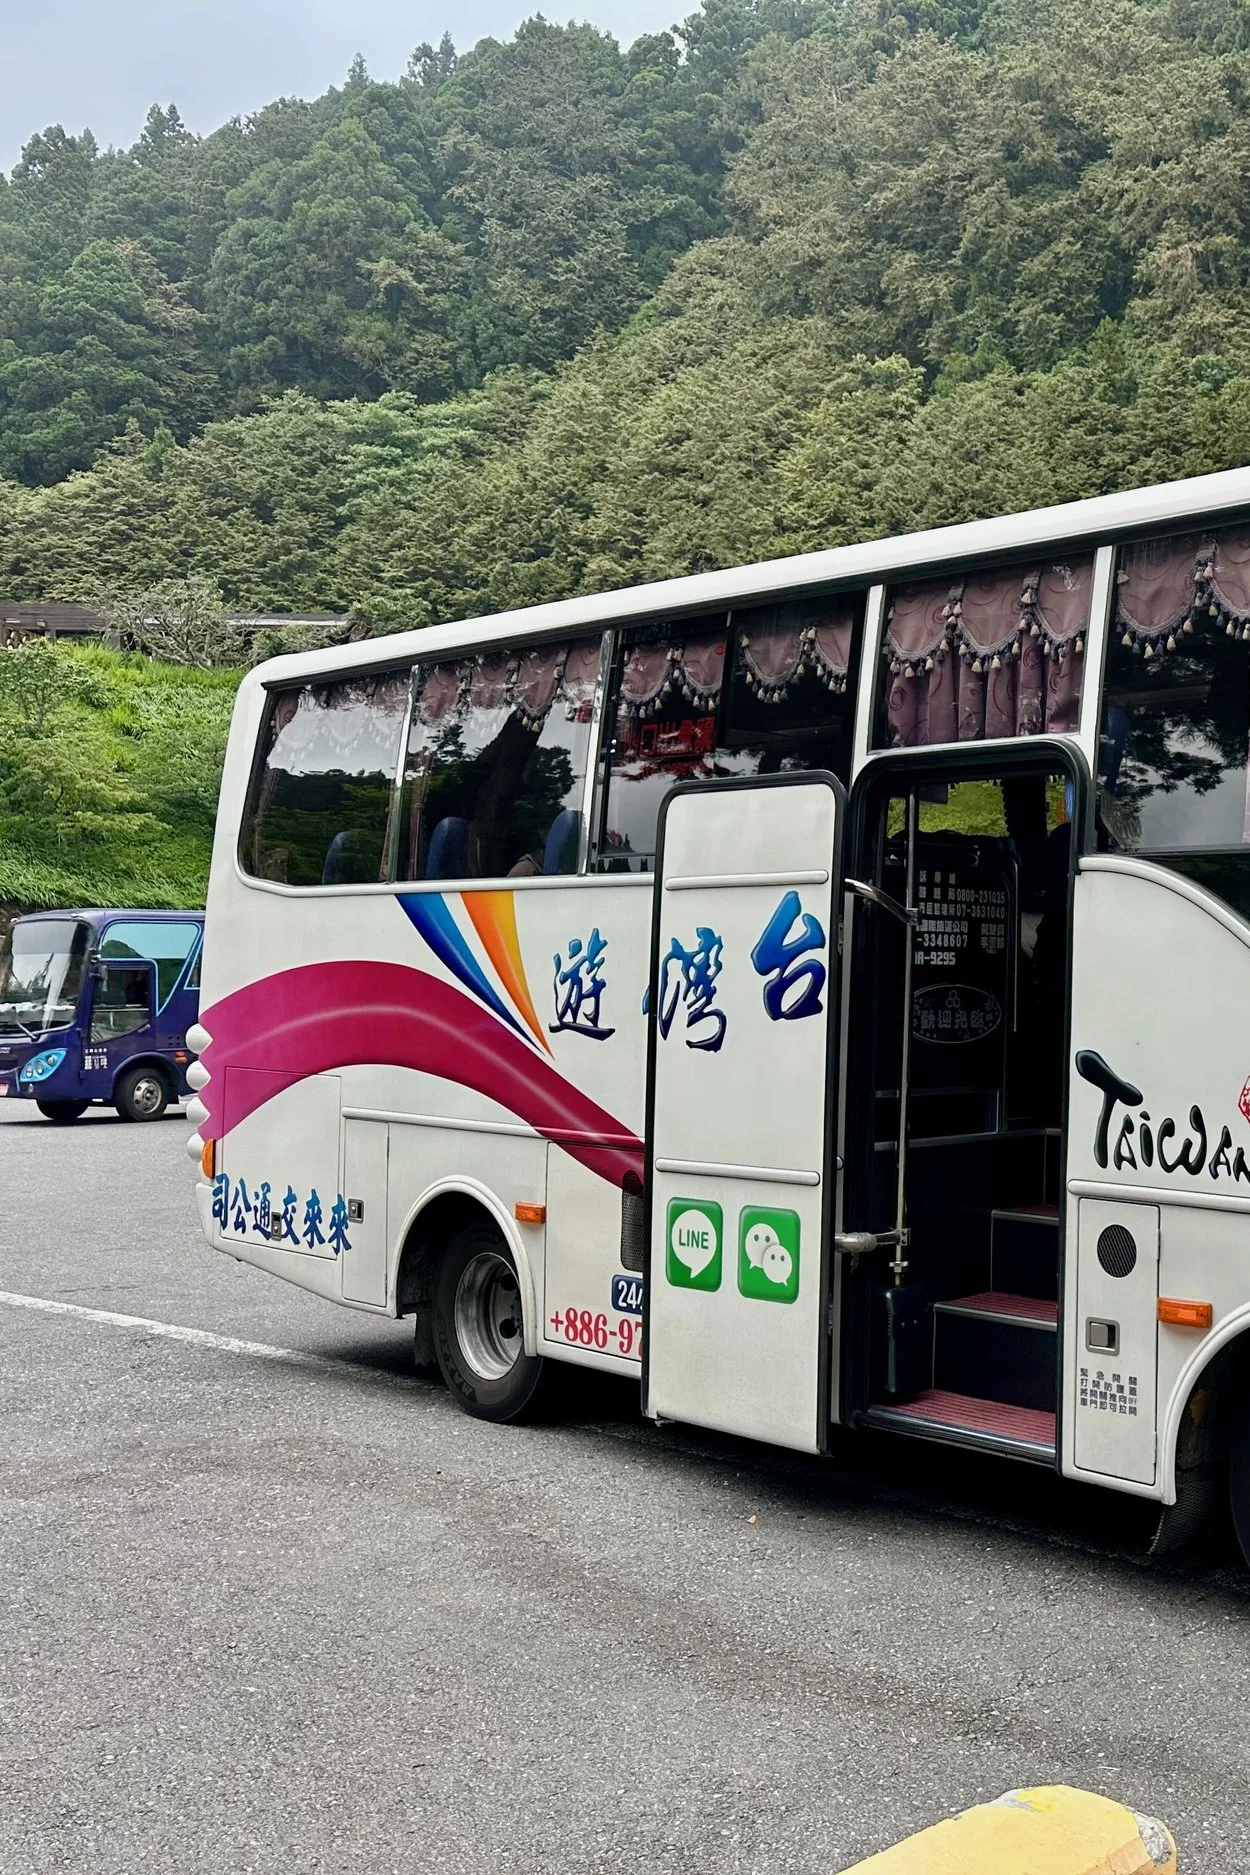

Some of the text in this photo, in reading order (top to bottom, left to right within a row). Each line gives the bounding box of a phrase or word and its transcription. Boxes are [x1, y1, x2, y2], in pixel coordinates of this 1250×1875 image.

[914, 951, 956, 965] A-9295
[678, 1228, 709, 1250] LINE
[1080, 1397, 1138, 1417] 車門即可拉開
